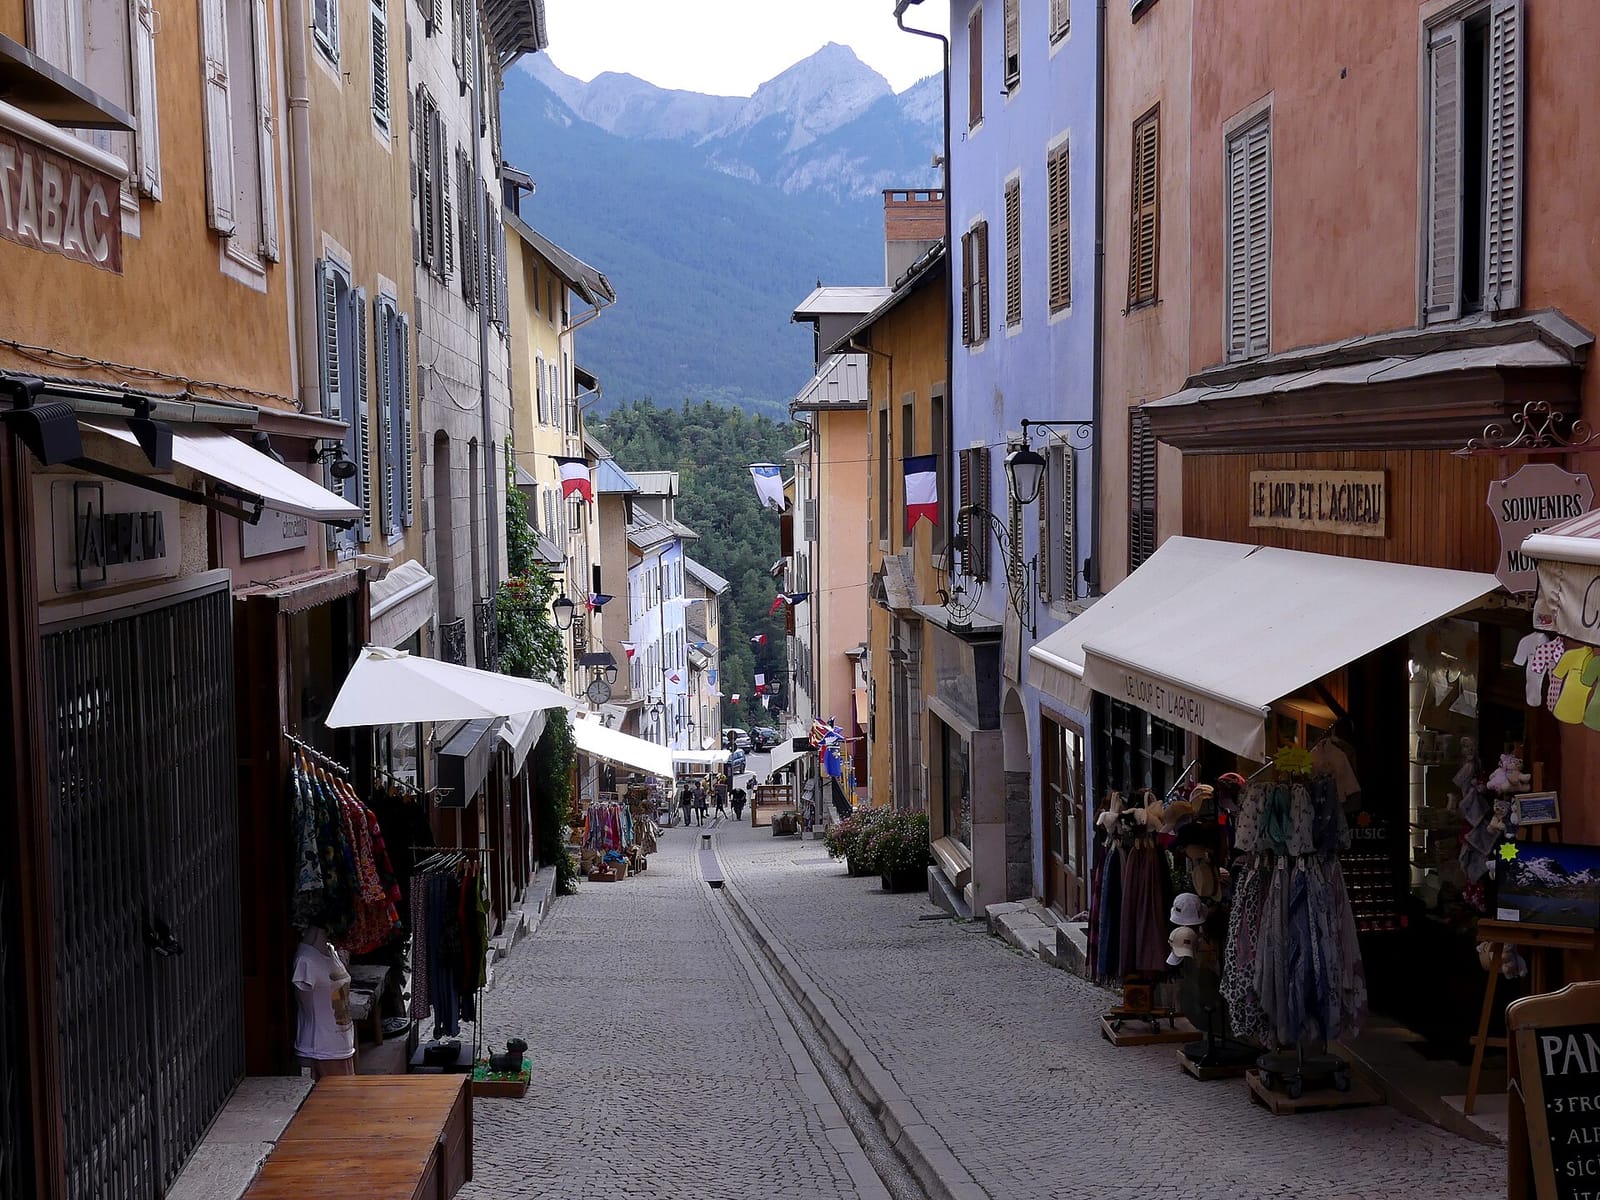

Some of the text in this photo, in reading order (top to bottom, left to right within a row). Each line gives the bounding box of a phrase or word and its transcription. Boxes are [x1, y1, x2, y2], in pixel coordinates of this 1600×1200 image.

[0, 142, 110, 262] TABAC
[1253, 480, 1382, 524] LE LOUP ET L'AGNEAU
[1502, 494, 1583, 522] SOUVENIRS
[1125, 675, 1205, 727] LE LOUP ET L'AGNEAU
[1350, 828, 1385, 840] USIC
[1554, 1098, 1564, 1113] 3
